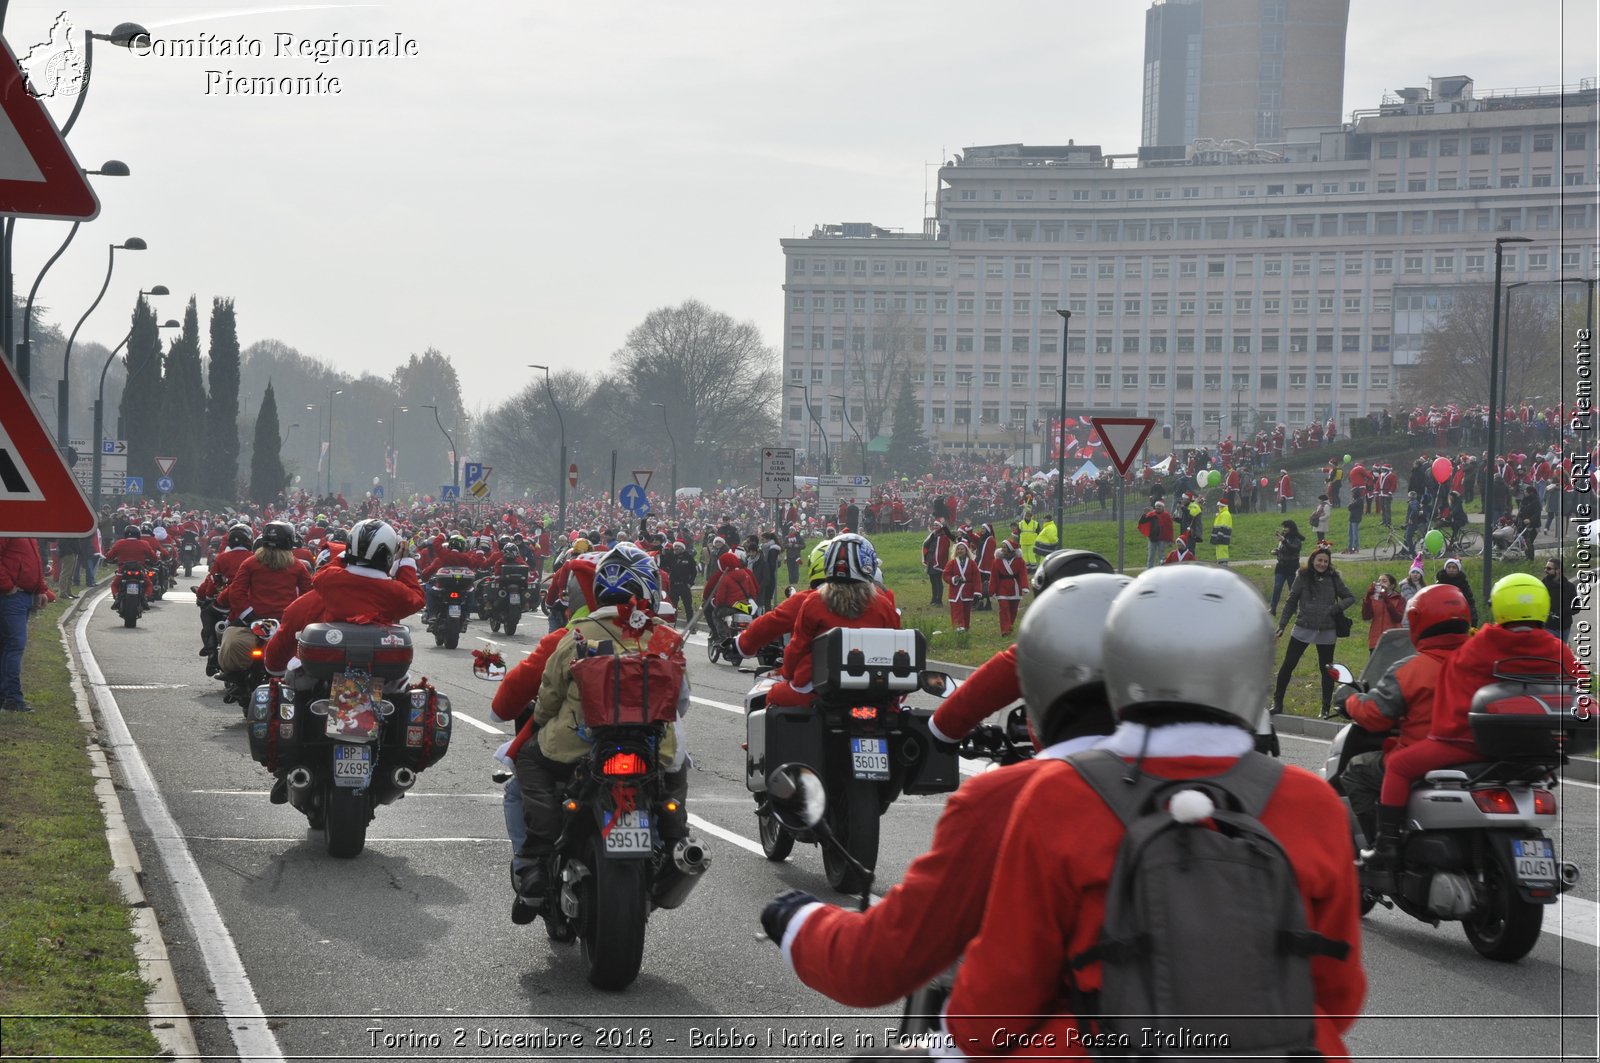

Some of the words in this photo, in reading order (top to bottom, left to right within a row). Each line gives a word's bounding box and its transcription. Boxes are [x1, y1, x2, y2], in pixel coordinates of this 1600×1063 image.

[470, 466, 478, 478] P
[861, 739, 874, 752] EJ
[338, 763, 369, 775] 24695
[855, 756, 887, 769] 36019
[608, 832, 650, 848] 59512
[1519, 860, 1553, 876] 40461
